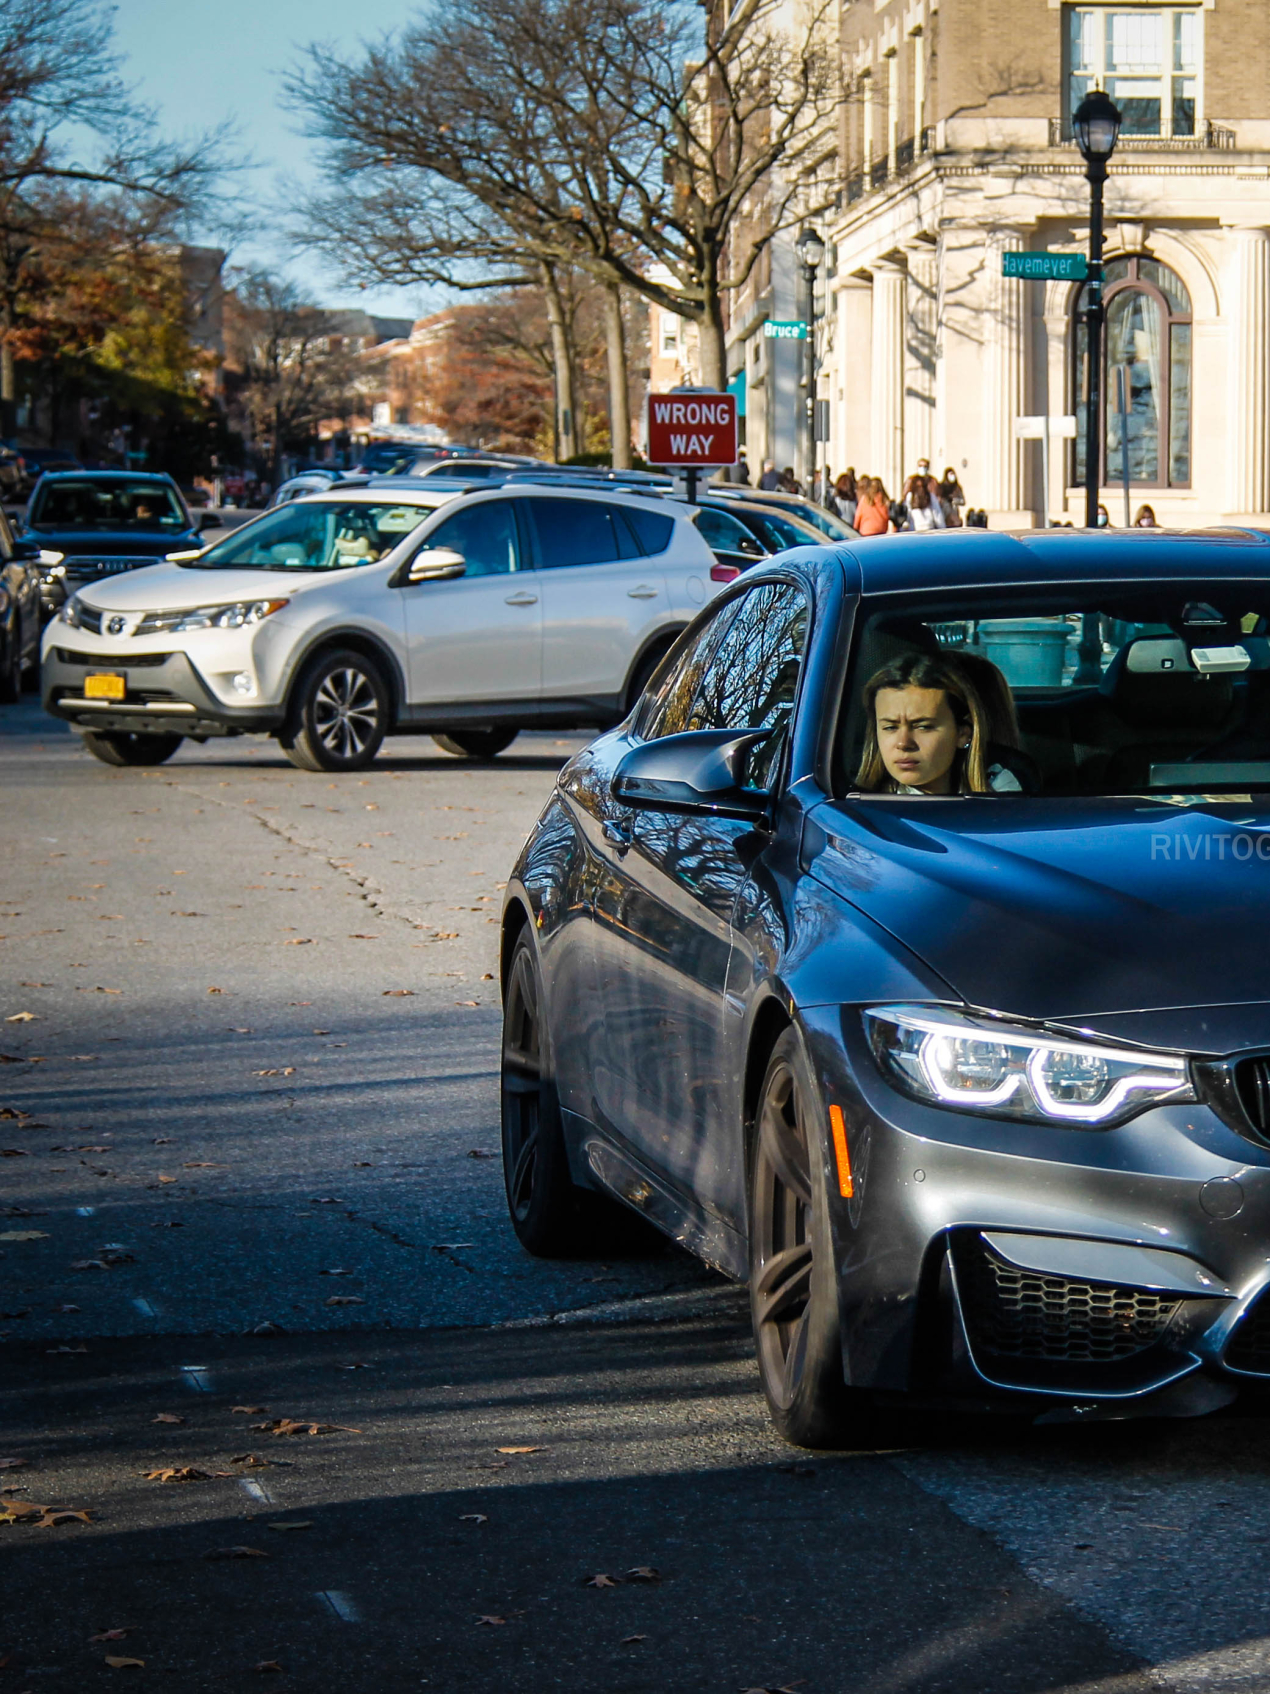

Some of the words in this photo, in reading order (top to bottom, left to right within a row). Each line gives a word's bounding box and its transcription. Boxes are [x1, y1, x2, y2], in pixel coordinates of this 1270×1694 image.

[1003, 254, 1073, 276] Havemeyer
[764, 322, 799, 338] Bruce
[654, 402, 730, 425] WRONG
[670, 434, 714, 455] WAY
